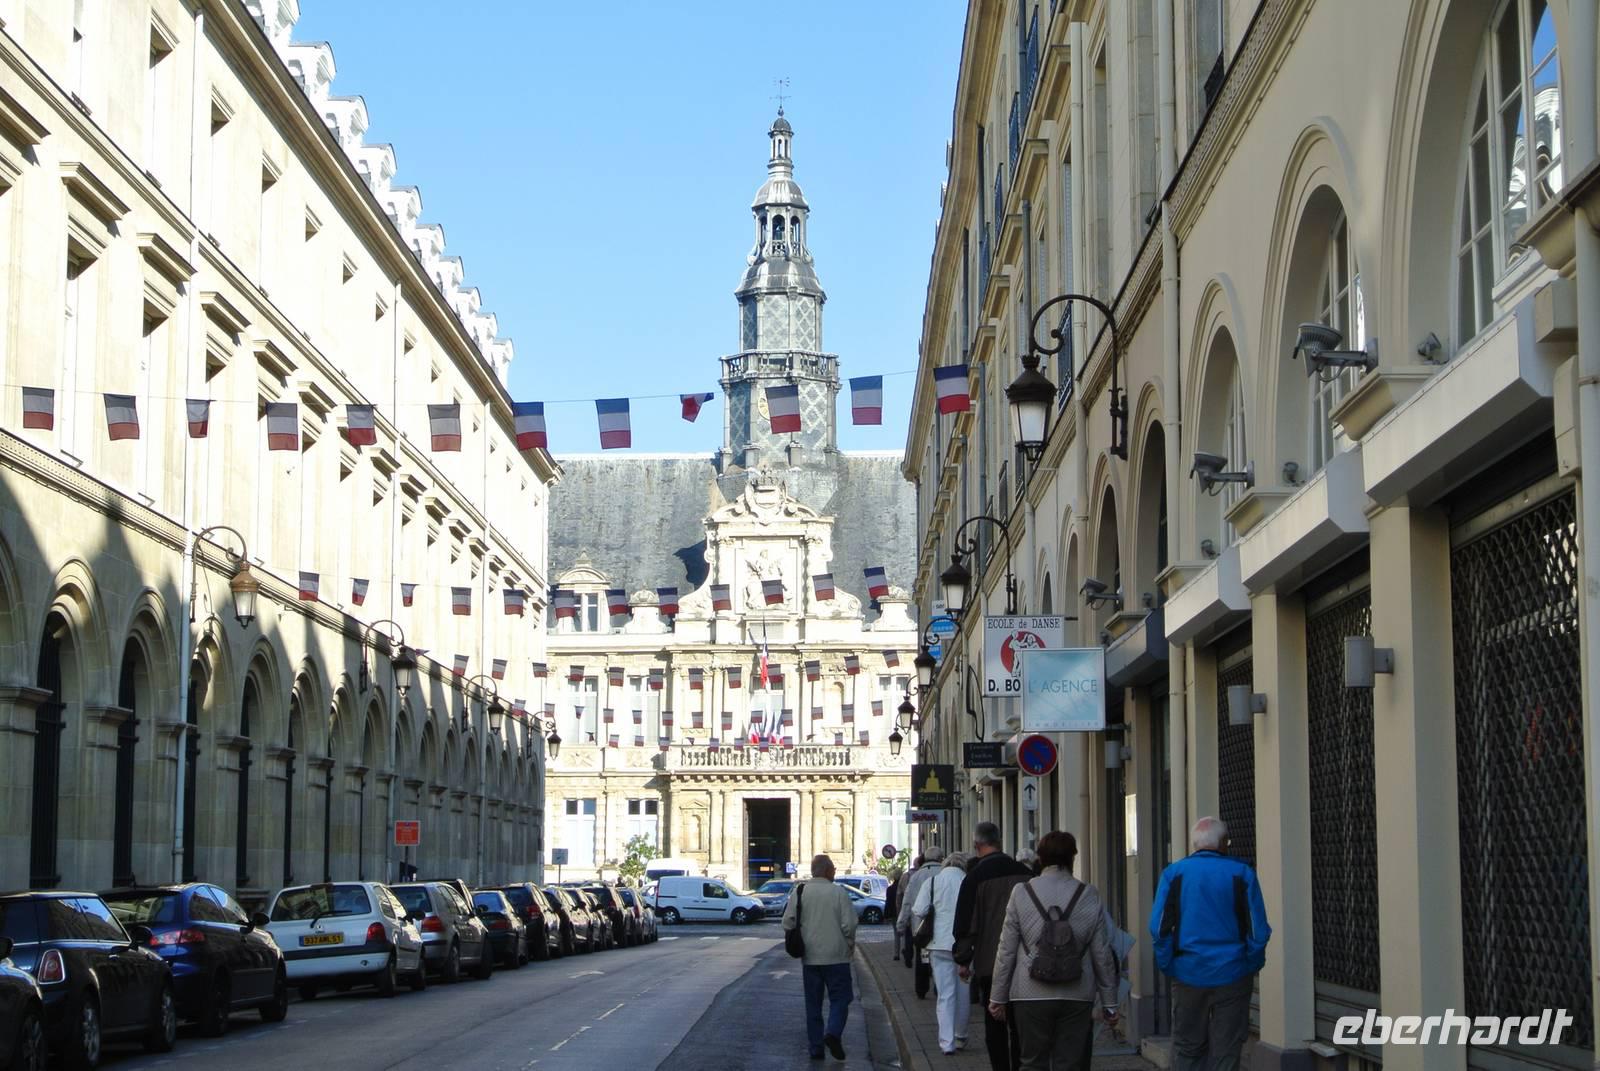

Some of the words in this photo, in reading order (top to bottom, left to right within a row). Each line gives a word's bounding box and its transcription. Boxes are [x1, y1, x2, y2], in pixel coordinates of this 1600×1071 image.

[988, 618, 1014, 629] ECOLE
[1019, 618, 1027, 629] de
[1032, 618, 1060, 629] DANSE
[988, 679, 1000, 692] D.
